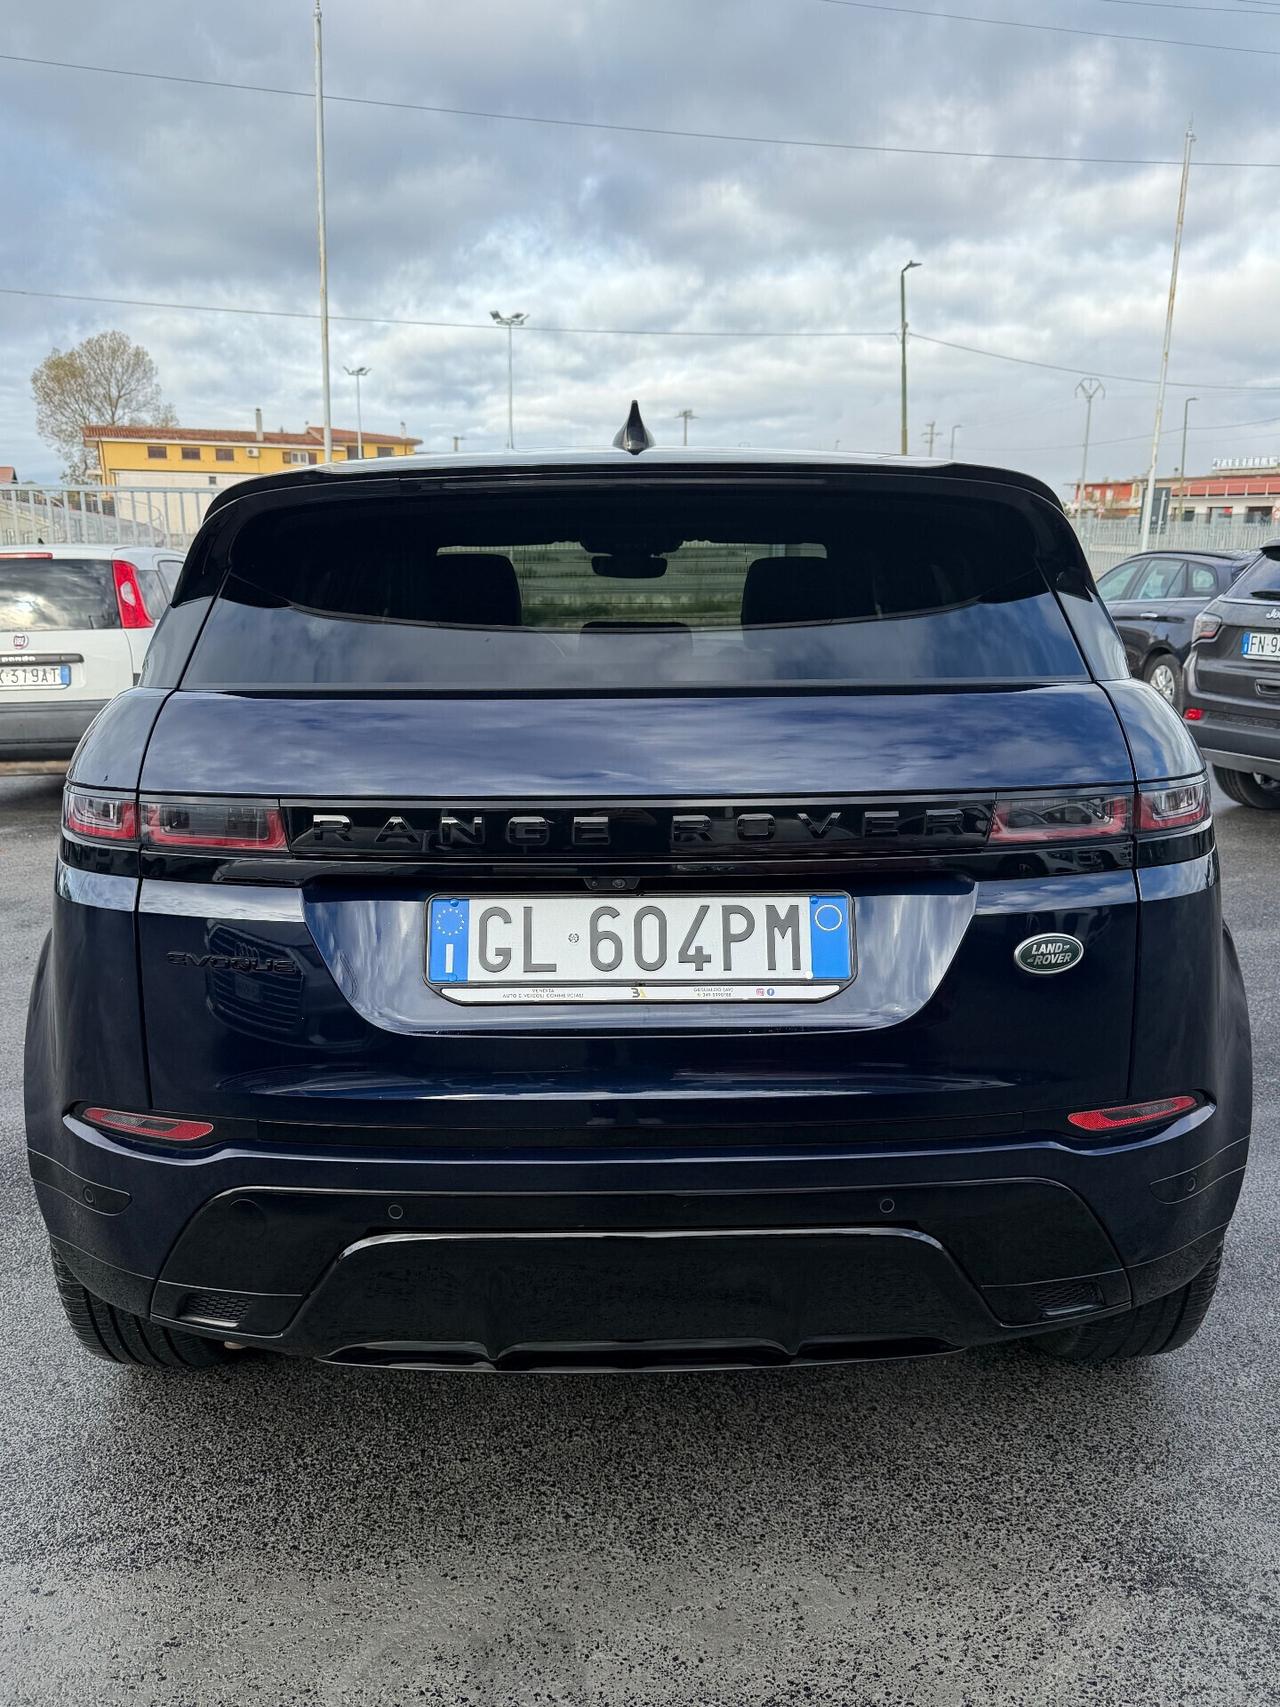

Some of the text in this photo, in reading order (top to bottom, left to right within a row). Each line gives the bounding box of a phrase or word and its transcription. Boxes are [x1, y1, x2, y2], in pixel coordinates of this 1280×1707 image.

[1250, 635, 1266, 653] FN
[10, 668, 60, 684] 319AT
[313, 808, 966, 845] RANGE ROVER
[478, 904, 801, 973] GL 604PM
[1031, 943, 1063, 955] LAND
[167, 951, 297, 975] EVOQUE
[1034, 952, 1072, 966] ROVER
